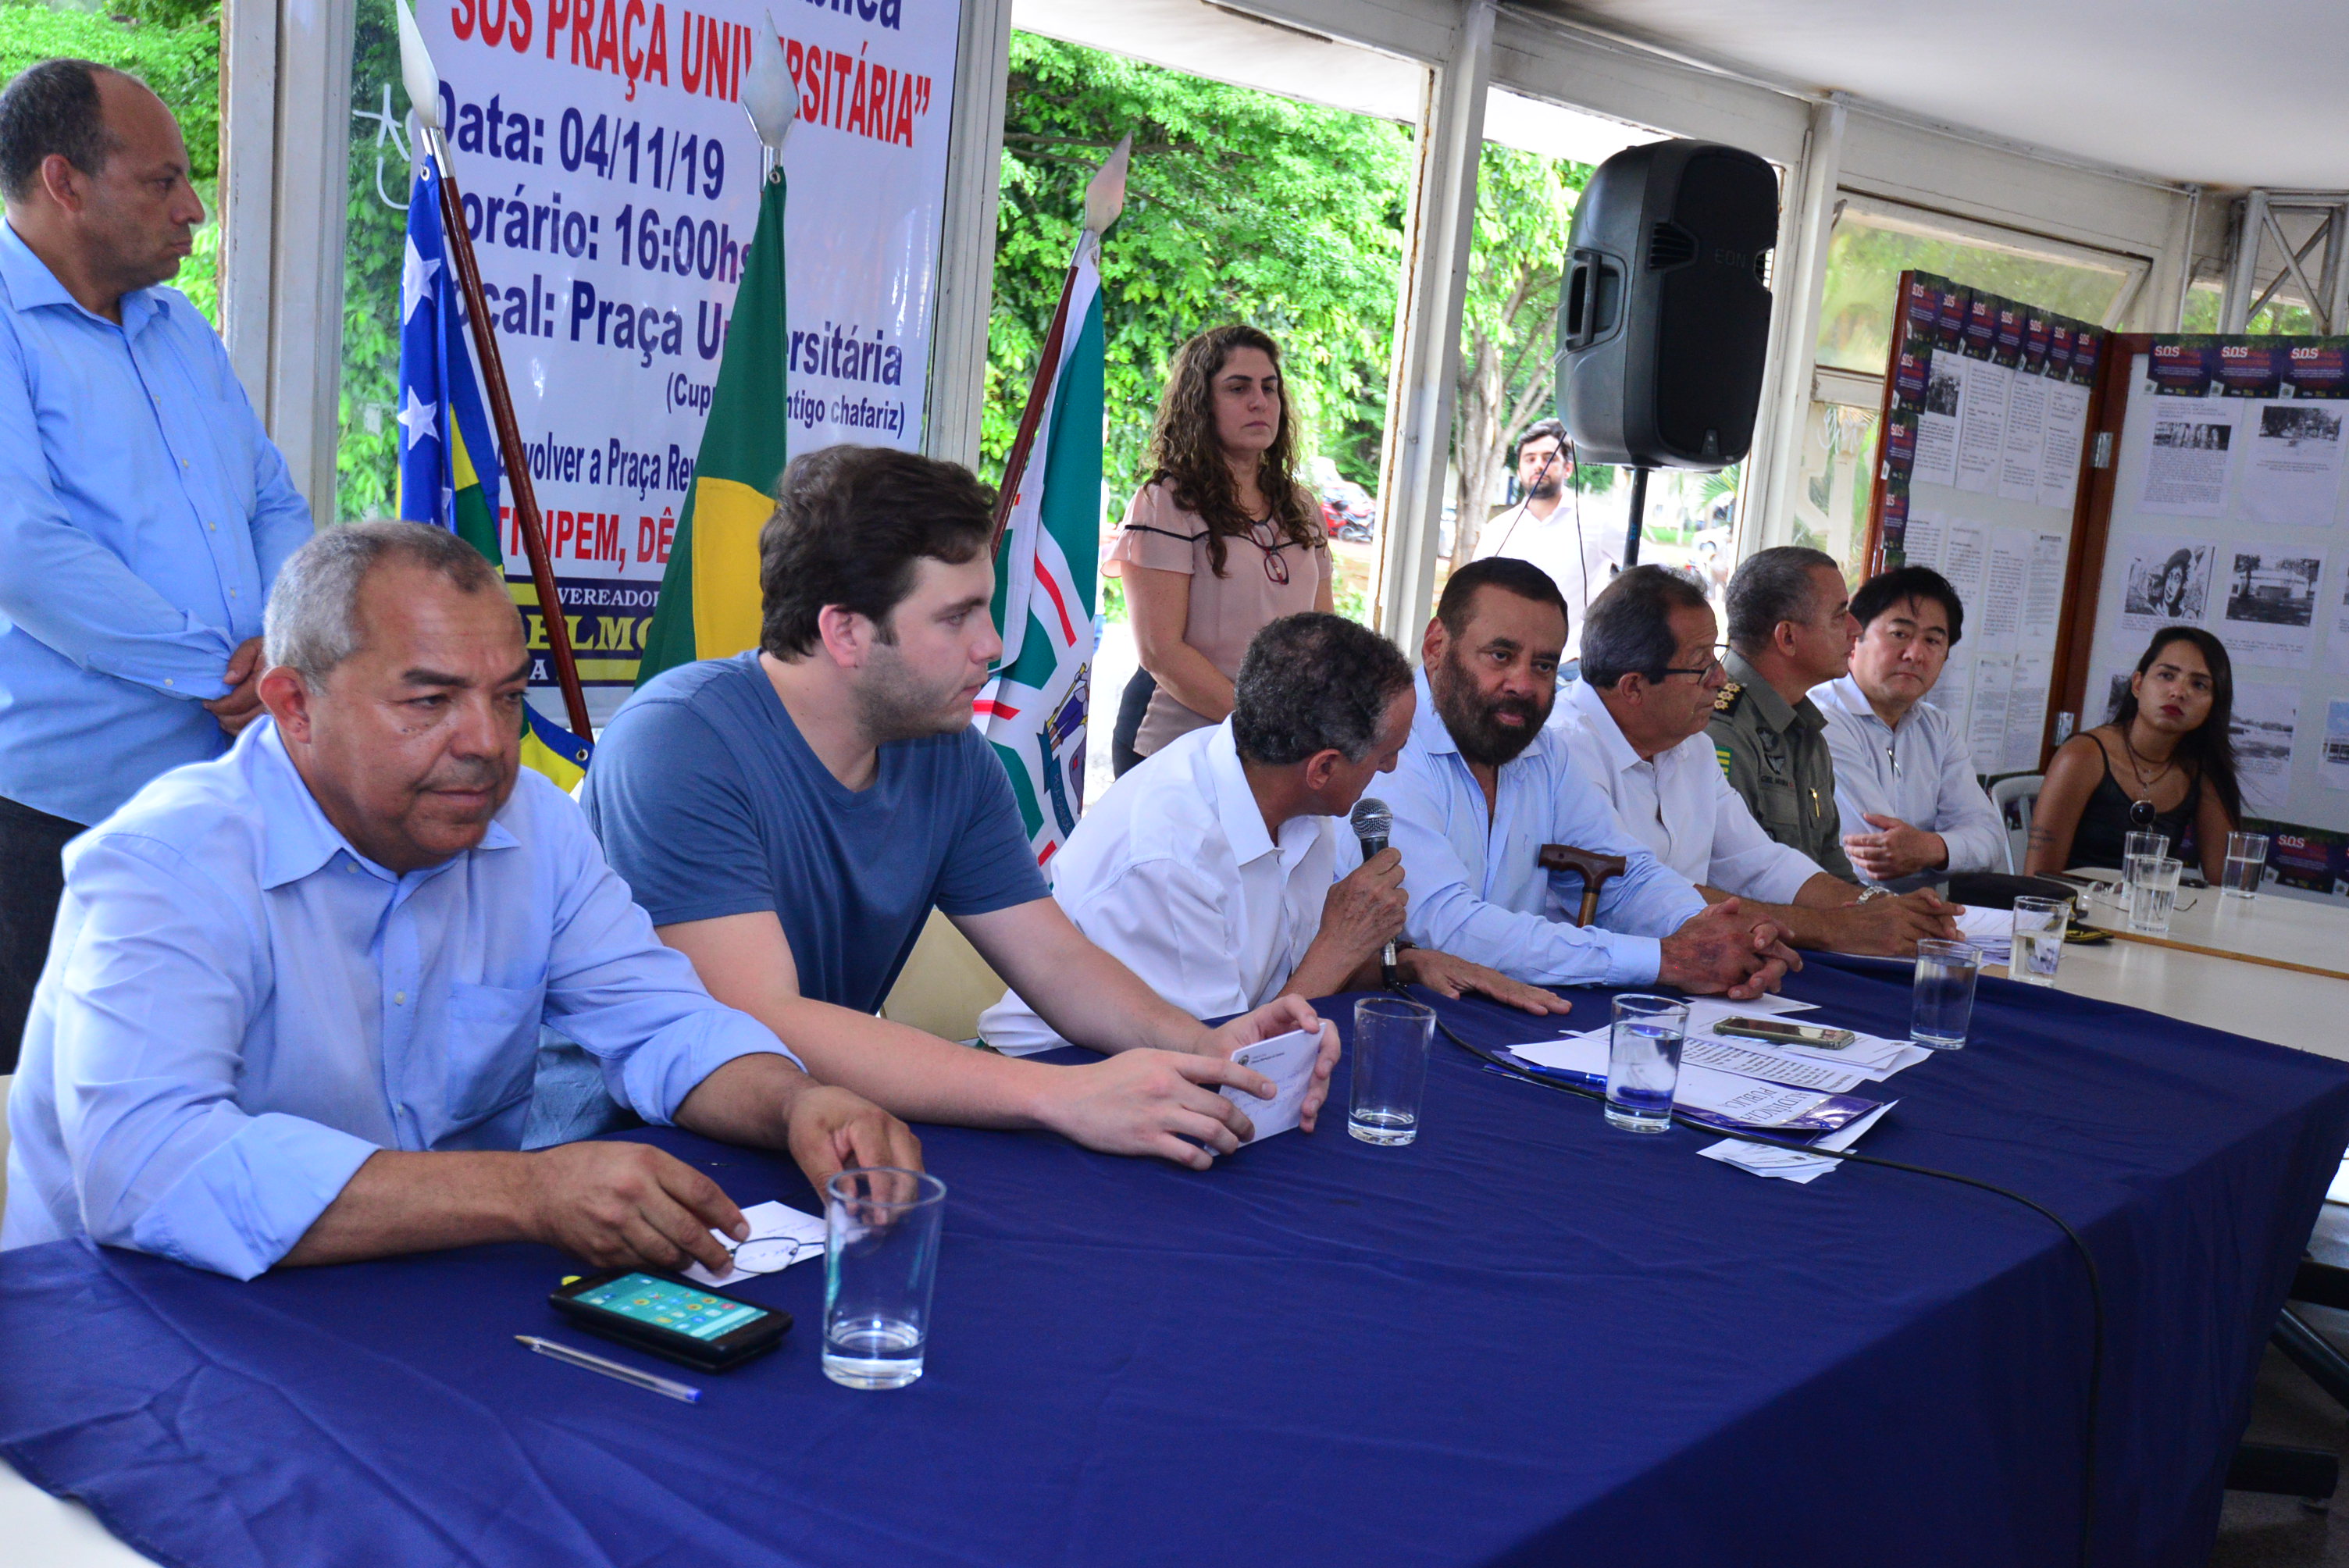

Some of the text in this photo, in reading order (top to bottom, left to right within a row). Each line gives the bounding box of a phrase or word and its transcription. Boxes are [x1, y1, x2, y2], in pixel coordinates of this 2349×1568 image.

[546, 0, 668, 102] PRAÇA
[681, 10, 931, 148] UNIRSITÁRIA”
[560, 107, 724, 201] 04/11/19
[462, 184, 599, 260] orário:
[454, 273, 554, 338] ocal:
[570, 280, 683, 368] Praça
[787, 390, 825, 429] ntigo
[831, 394, 904, 439] chafariz)
[590, 448, 601, 484] a
[607, 437, 661, 501] Praça
[1740, 1092, 1813, 1123] AUDIÊNCIA
